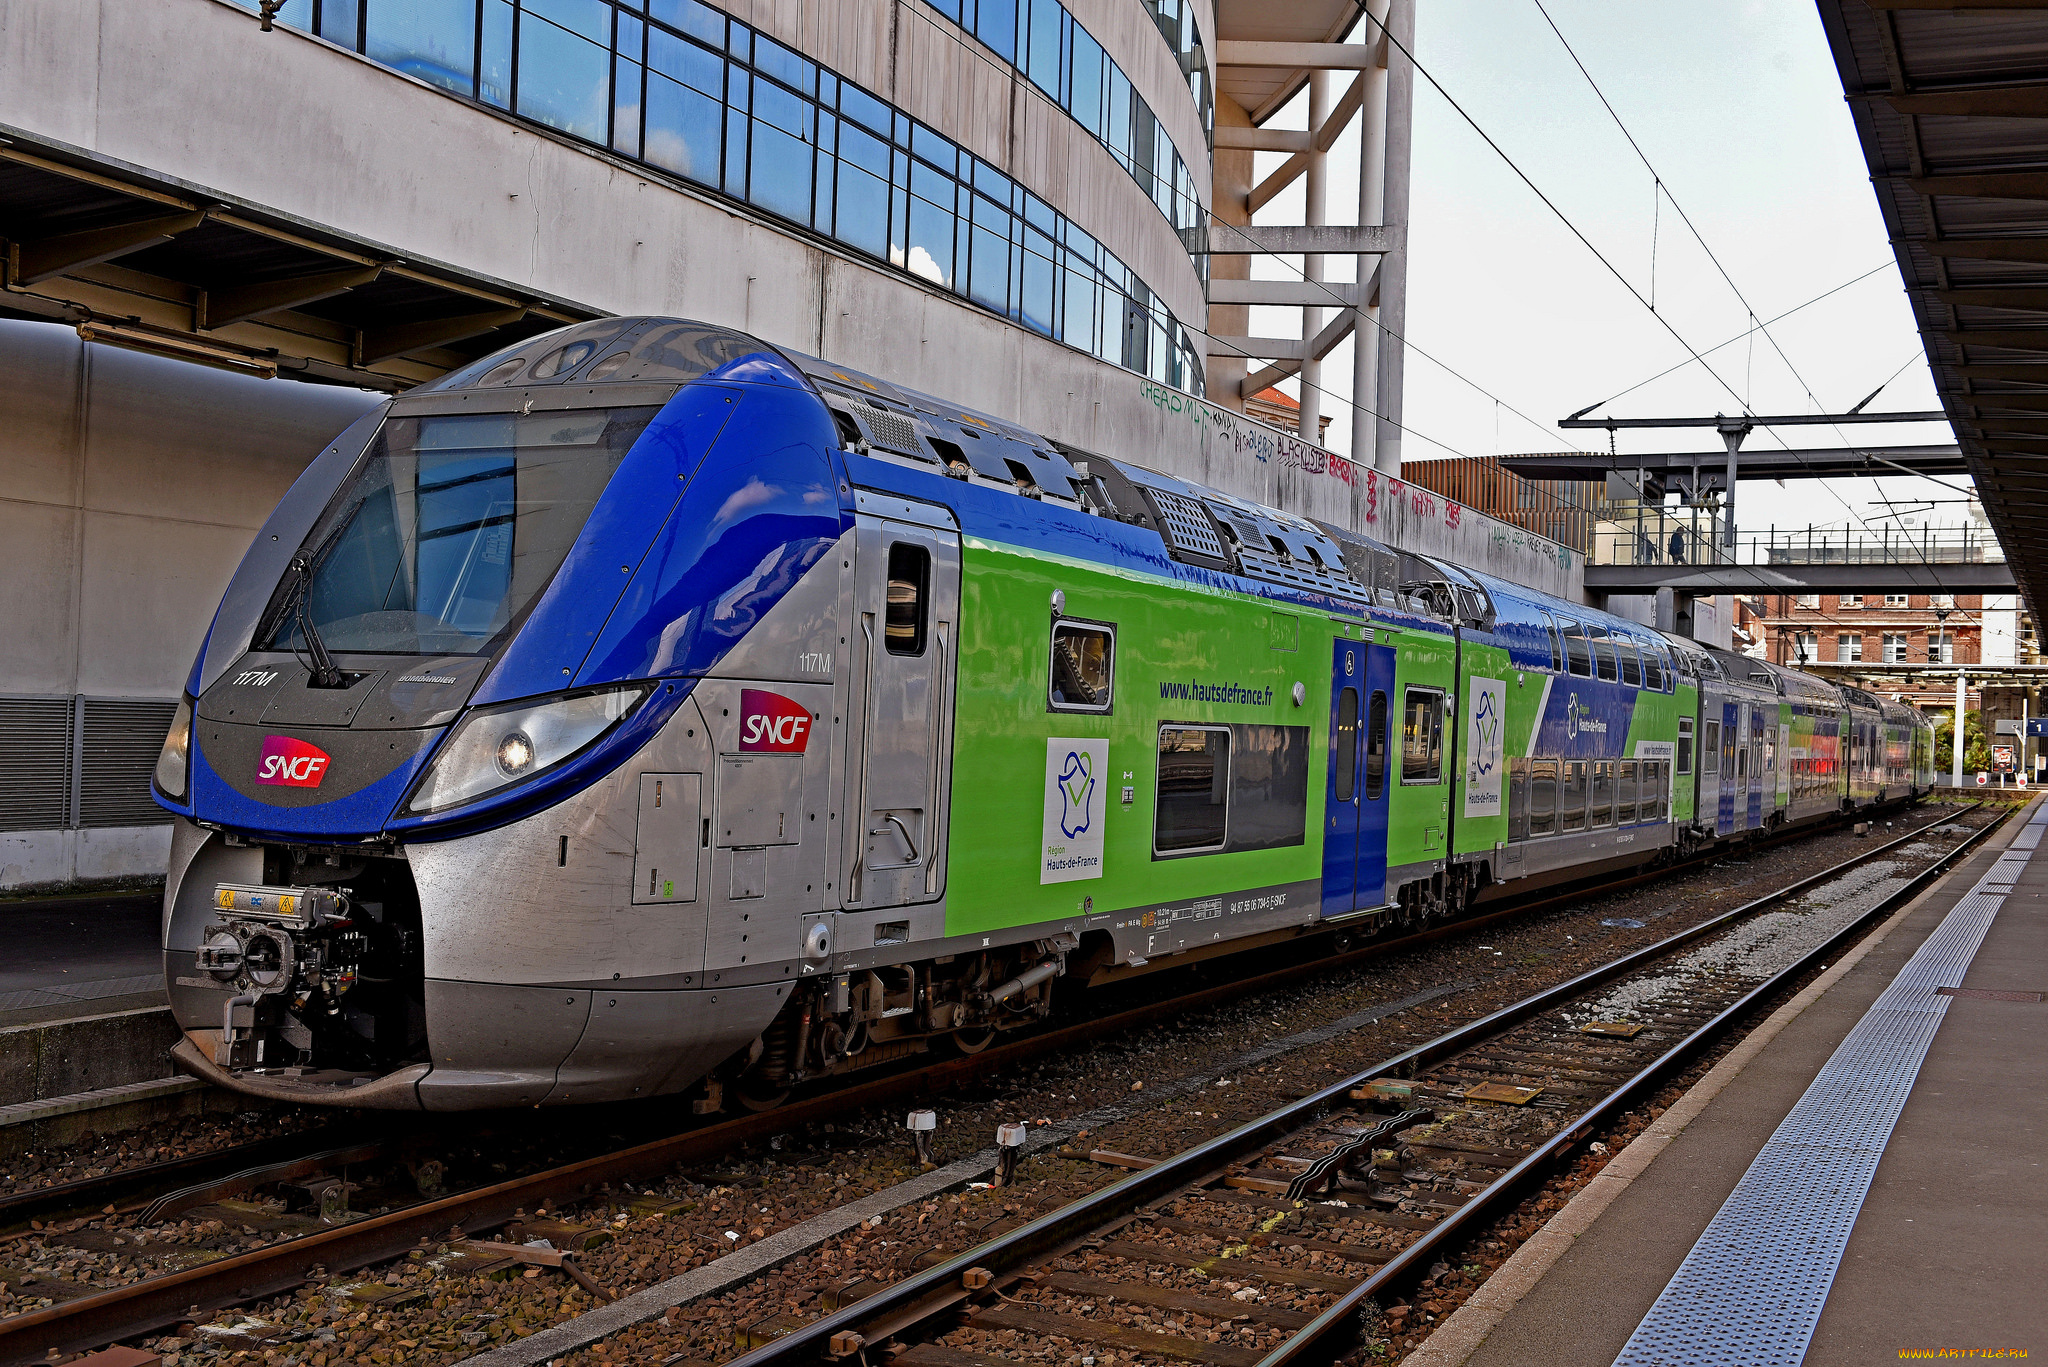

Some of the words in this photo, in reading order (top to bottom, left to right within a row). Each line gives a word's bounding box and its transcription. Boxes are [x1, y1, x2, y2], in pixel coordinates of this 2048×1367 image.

[799, 652, 831, 673] 117M
[232, 671, 278, 687] 117M
[397, 675, 457, 685] BOMBARDIER
[1159, 678, 1273, 707] www.hautsdefrance.fr
[742, 714, 808, 745] SNCF
[2036, 724, 2042, 732] 1
[258, 755, 326, 781] SNCF
[1468, 792, 1498, 804] Hauts-de-France
[1047, 845, 1067, 857] Région
[1046, 856, 1098, 871] Hauts-de-France
